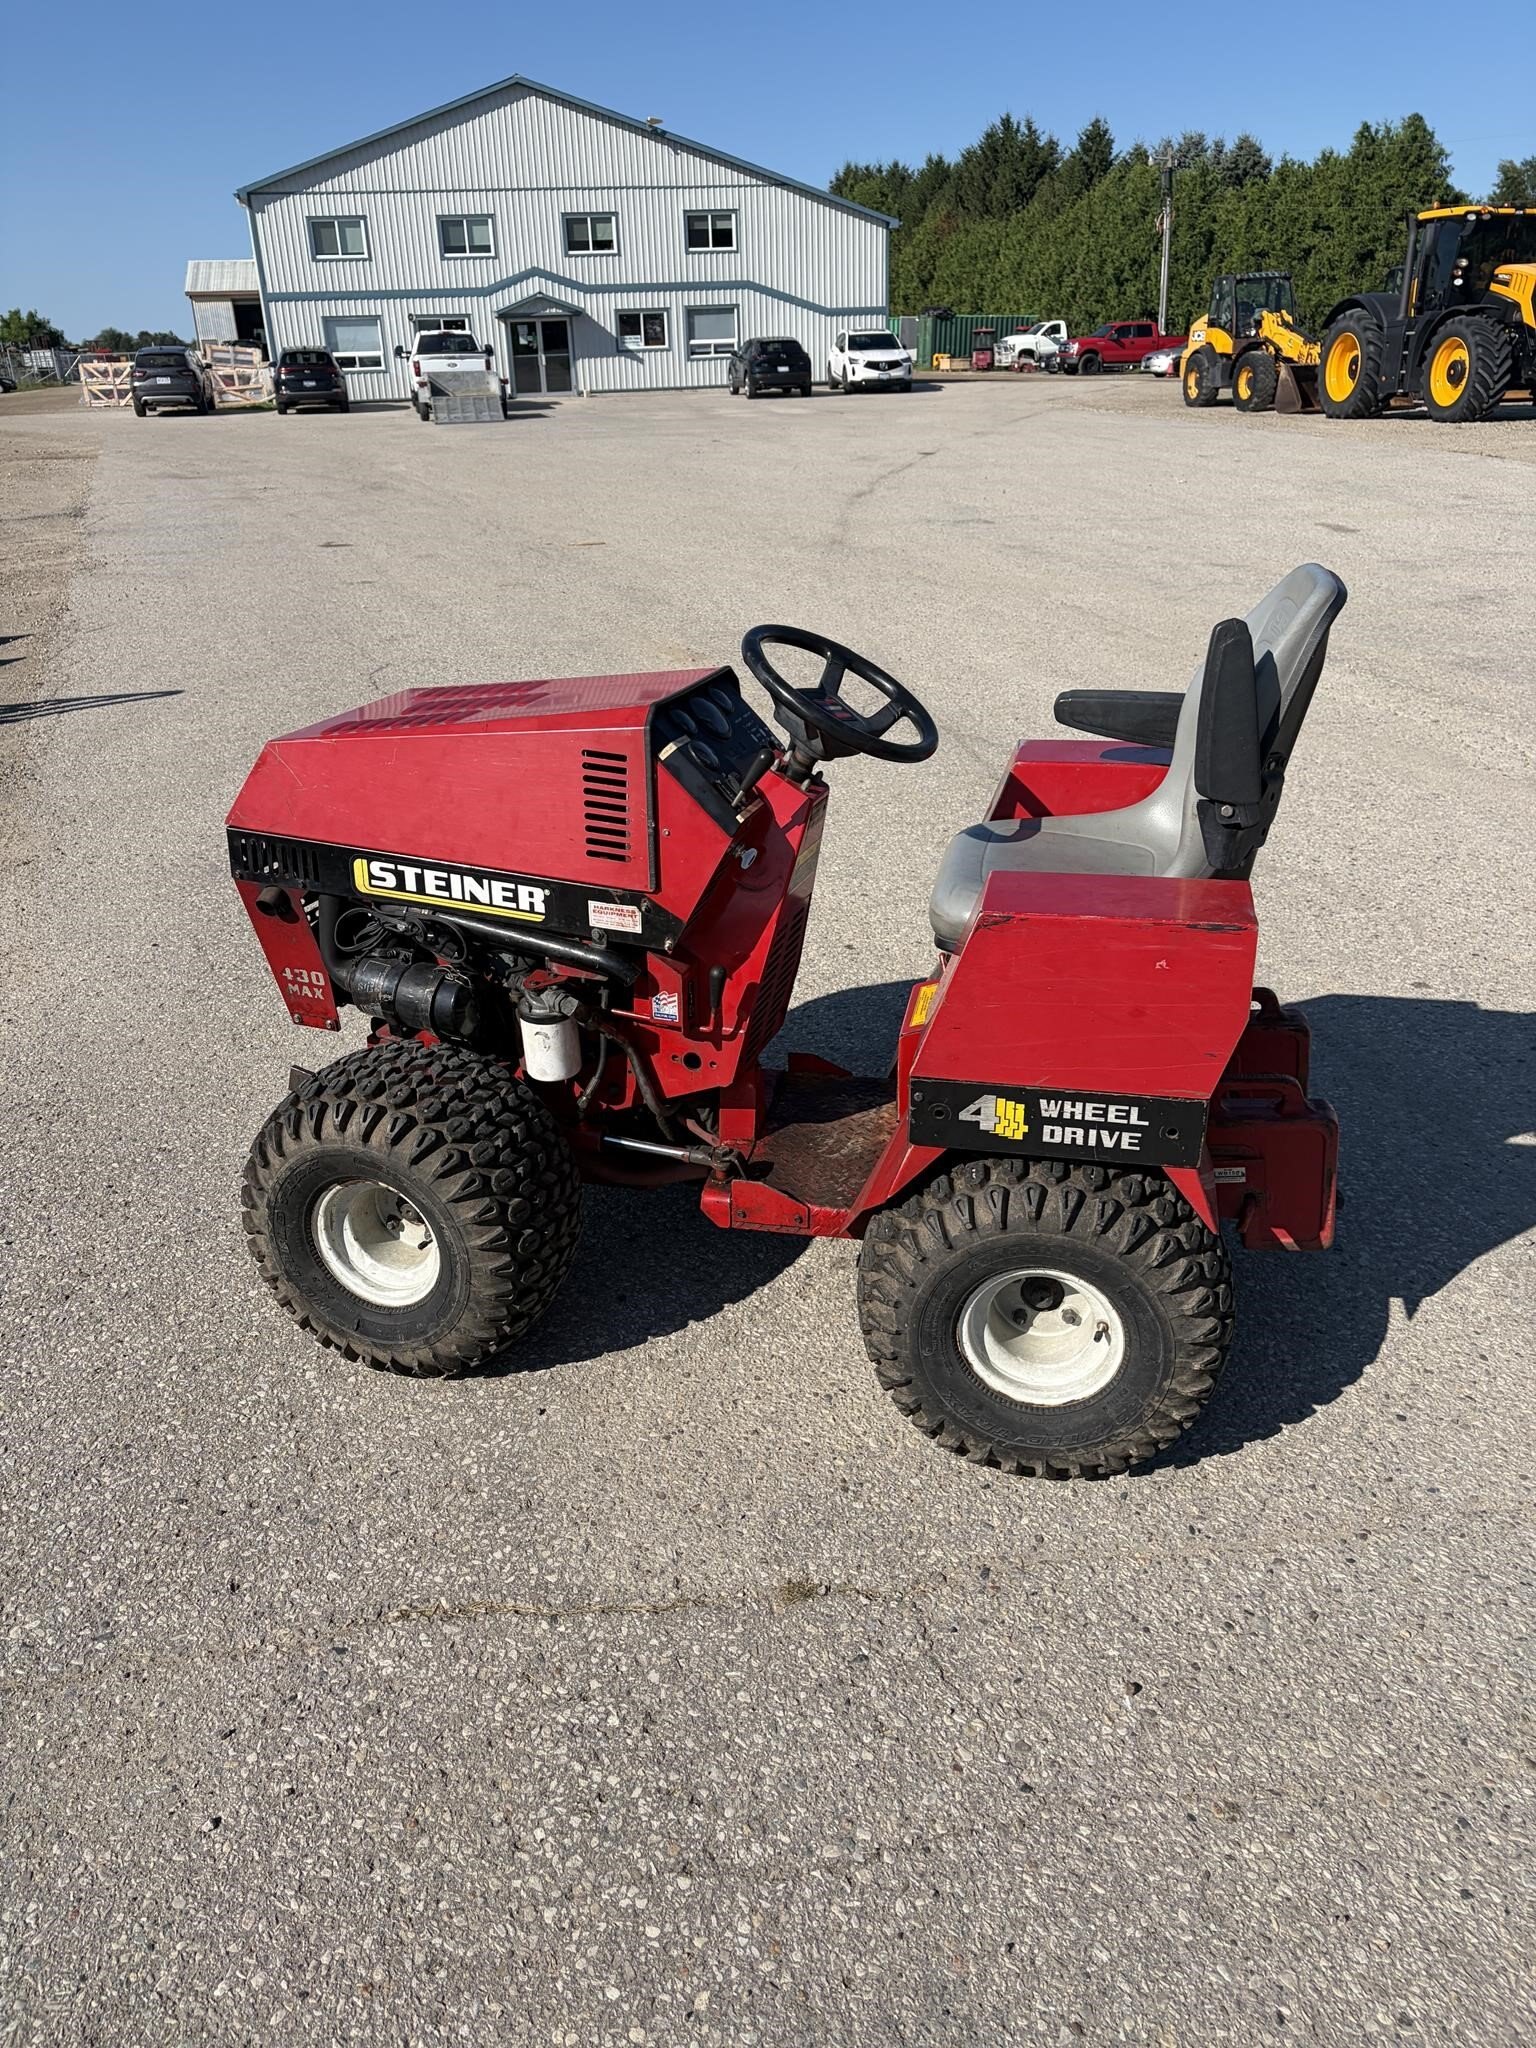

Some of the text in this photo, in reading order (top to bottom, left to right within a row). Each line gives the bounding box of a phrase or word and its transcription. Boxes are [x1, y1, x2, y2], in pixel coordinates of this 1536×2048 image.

[370, 861, 545, 914] STEINER
[592, 909, 638, 919] EQUIPMENT
[593, 905, 637, 914] HARKNESS
[288, 984, 324, 1000] MAX
[959, 1094, 1149, 1132] 4 WHEEL
[1042, 1125, 1142, 1151] DRIVE
